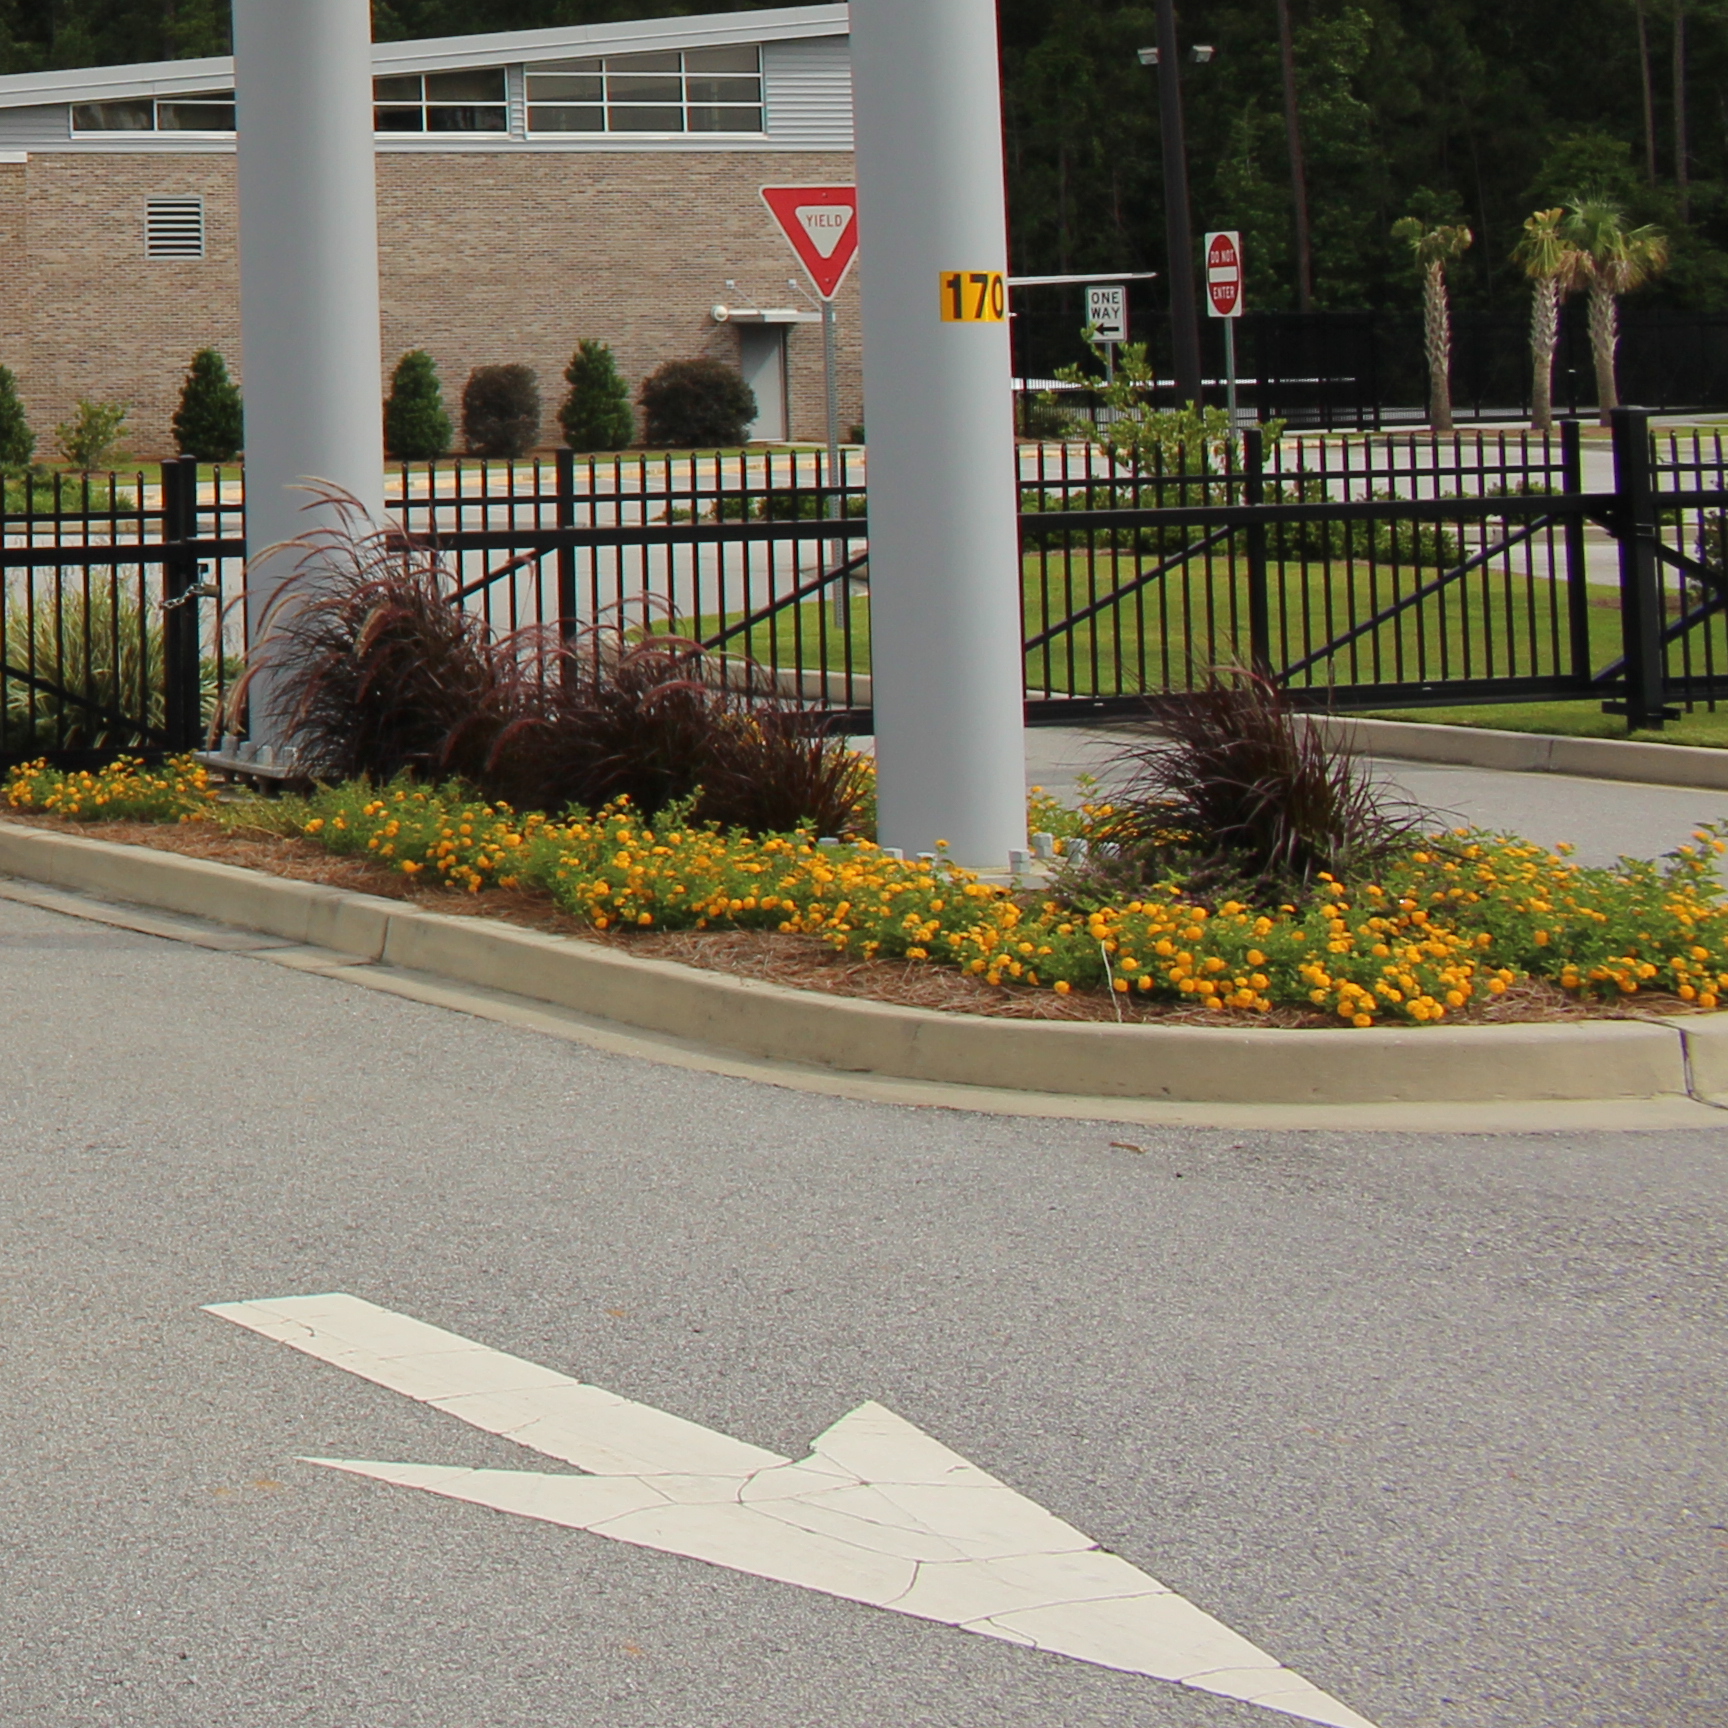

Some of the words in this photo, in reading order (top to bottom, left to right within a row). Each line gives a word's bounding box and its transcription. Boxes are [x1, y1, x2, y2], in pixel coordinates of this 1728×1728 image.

[805, 213, 843, 228] YIELD
[1209, 249, 1221, 264] DO
[1221, 248, 1235, 263] NOT
[946, 273, 1005, 320] 170
[1090, 290, 1120, 305] ONE
[1213, 284, 1235, 300] ENTER
[1090, 306, 1121, 320] WAY
